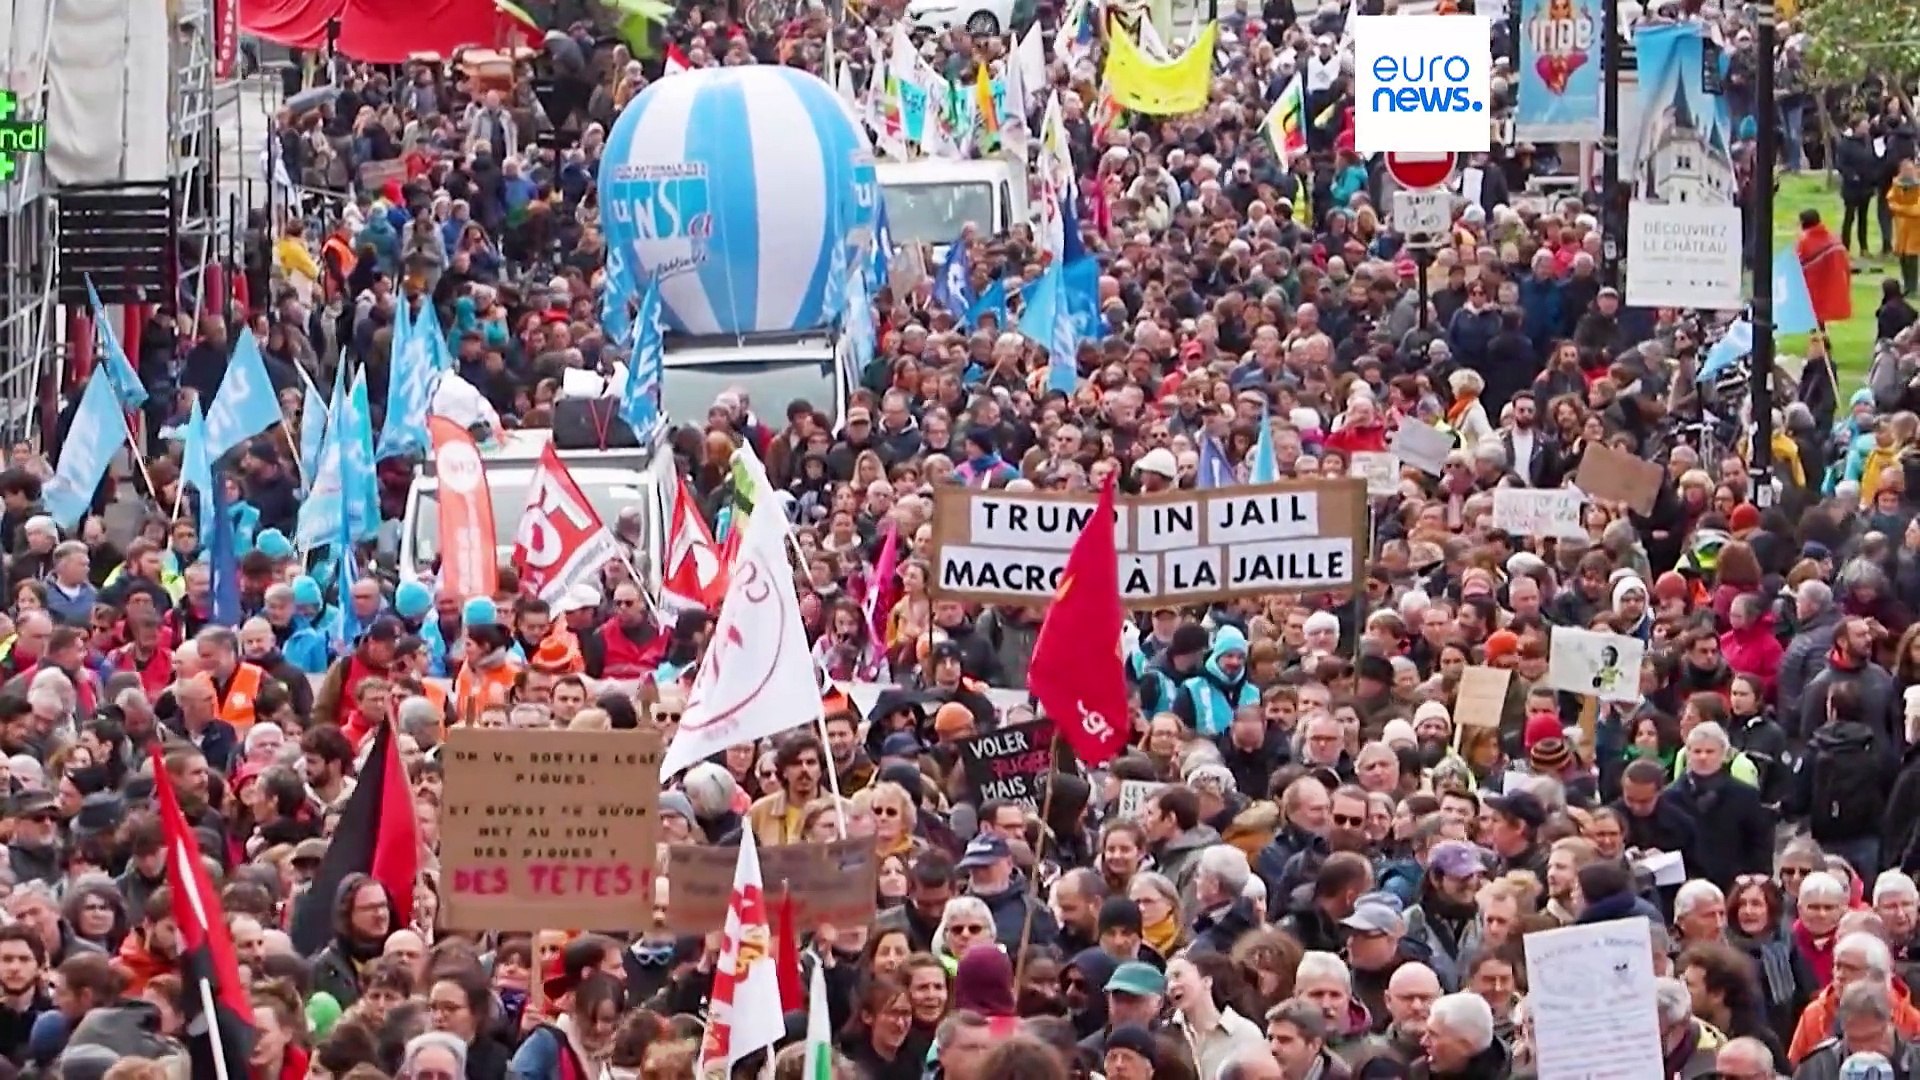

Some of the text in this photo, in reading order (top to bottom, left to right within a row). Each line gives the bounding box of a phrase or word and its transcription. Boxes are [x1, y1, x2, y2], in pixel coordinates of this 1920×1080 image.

[982, 495, 1307, 536] TRUM IN JAIL
[944, 550, 1343, 594] MACR À LA JAILLE
[968, 730, 1030, 761] VOLER
[980, 775, 1028, 803] MAIS
[527, 827, 550, 838] AU
[453, 867, 509, 894] DES
